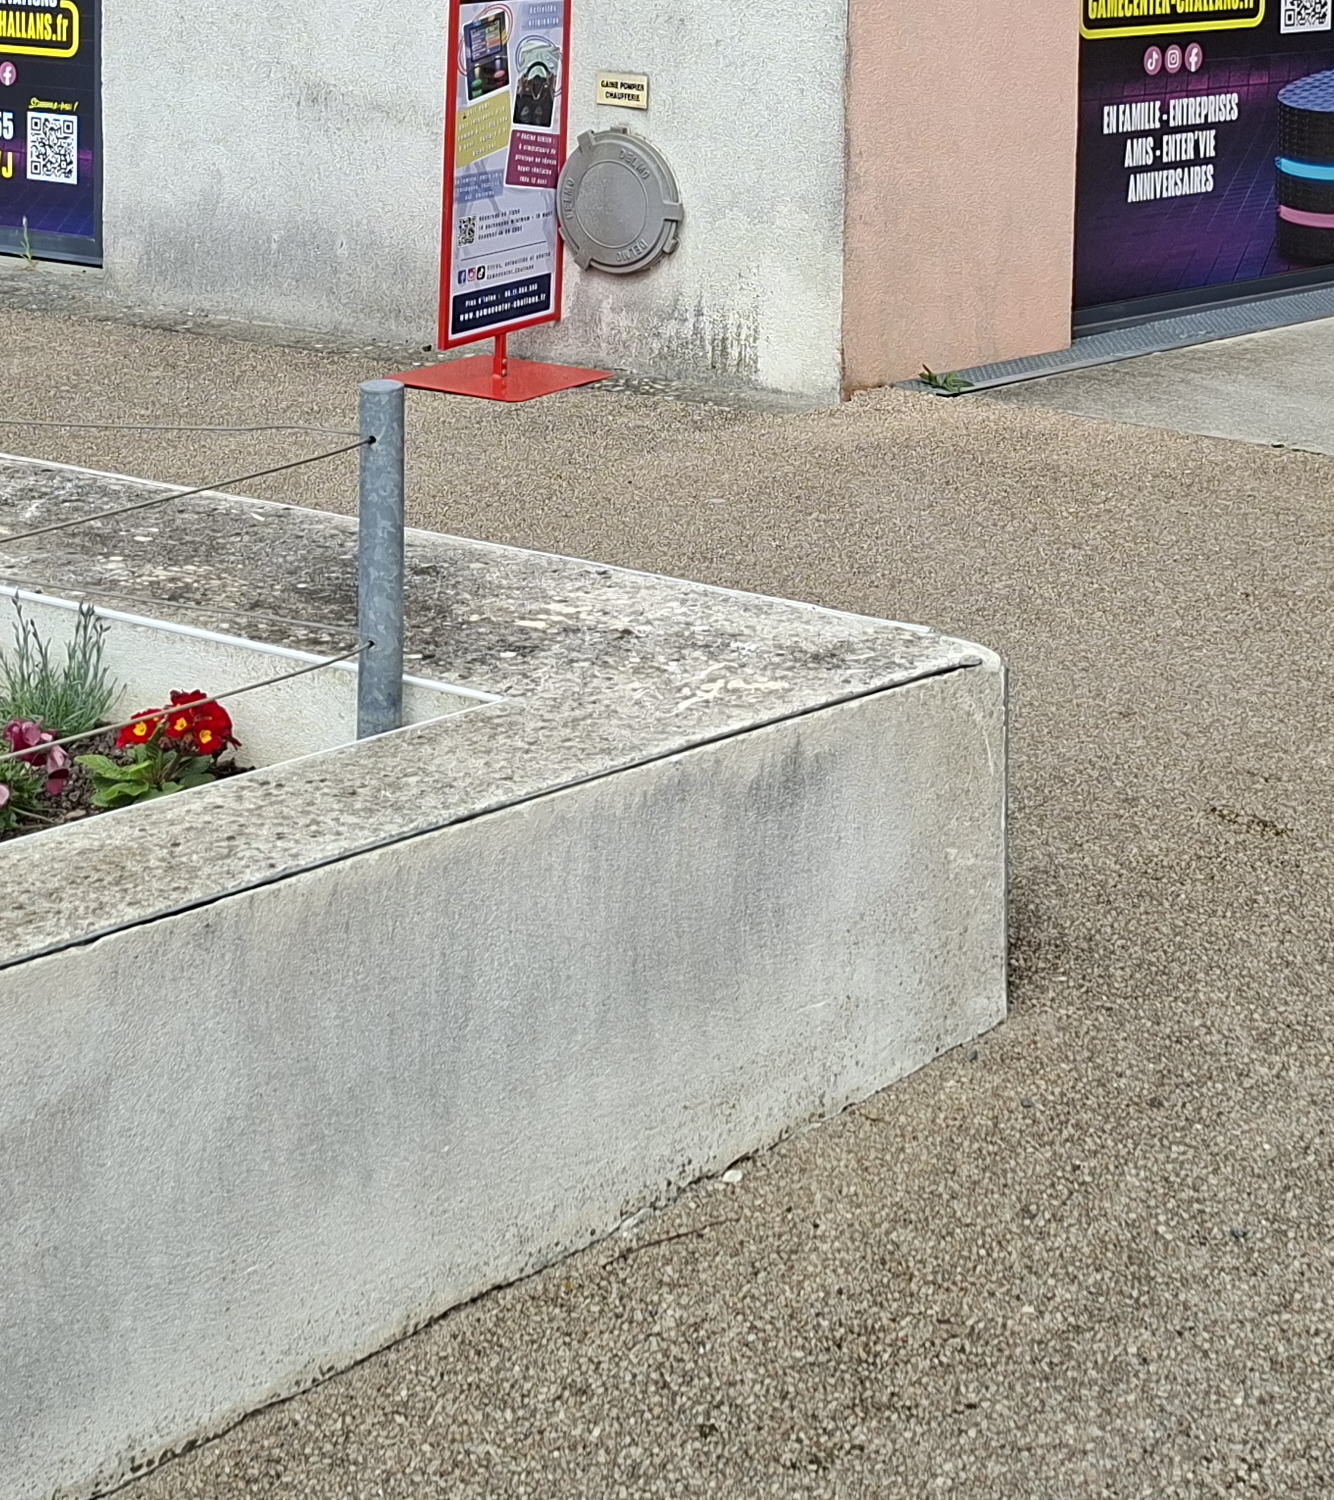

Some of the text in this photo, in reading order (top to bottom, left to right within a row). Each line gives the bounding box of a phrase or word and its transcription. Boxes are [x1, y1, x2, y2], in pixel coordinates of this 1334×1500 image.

[1103, 105, 1117, 134] EN
[1118, 100, 1161, 133] FAMILLE
[1169, 92, 1239, 127] ENTREPRISES
[618, 148, 651, 181] DELMO
[1124, 136, 1154, 168] AMIS
[1162, 129, 1216, 163] ENTER'VIE
[1127, 164, 1214, 203] ANNIVERSAIRES
